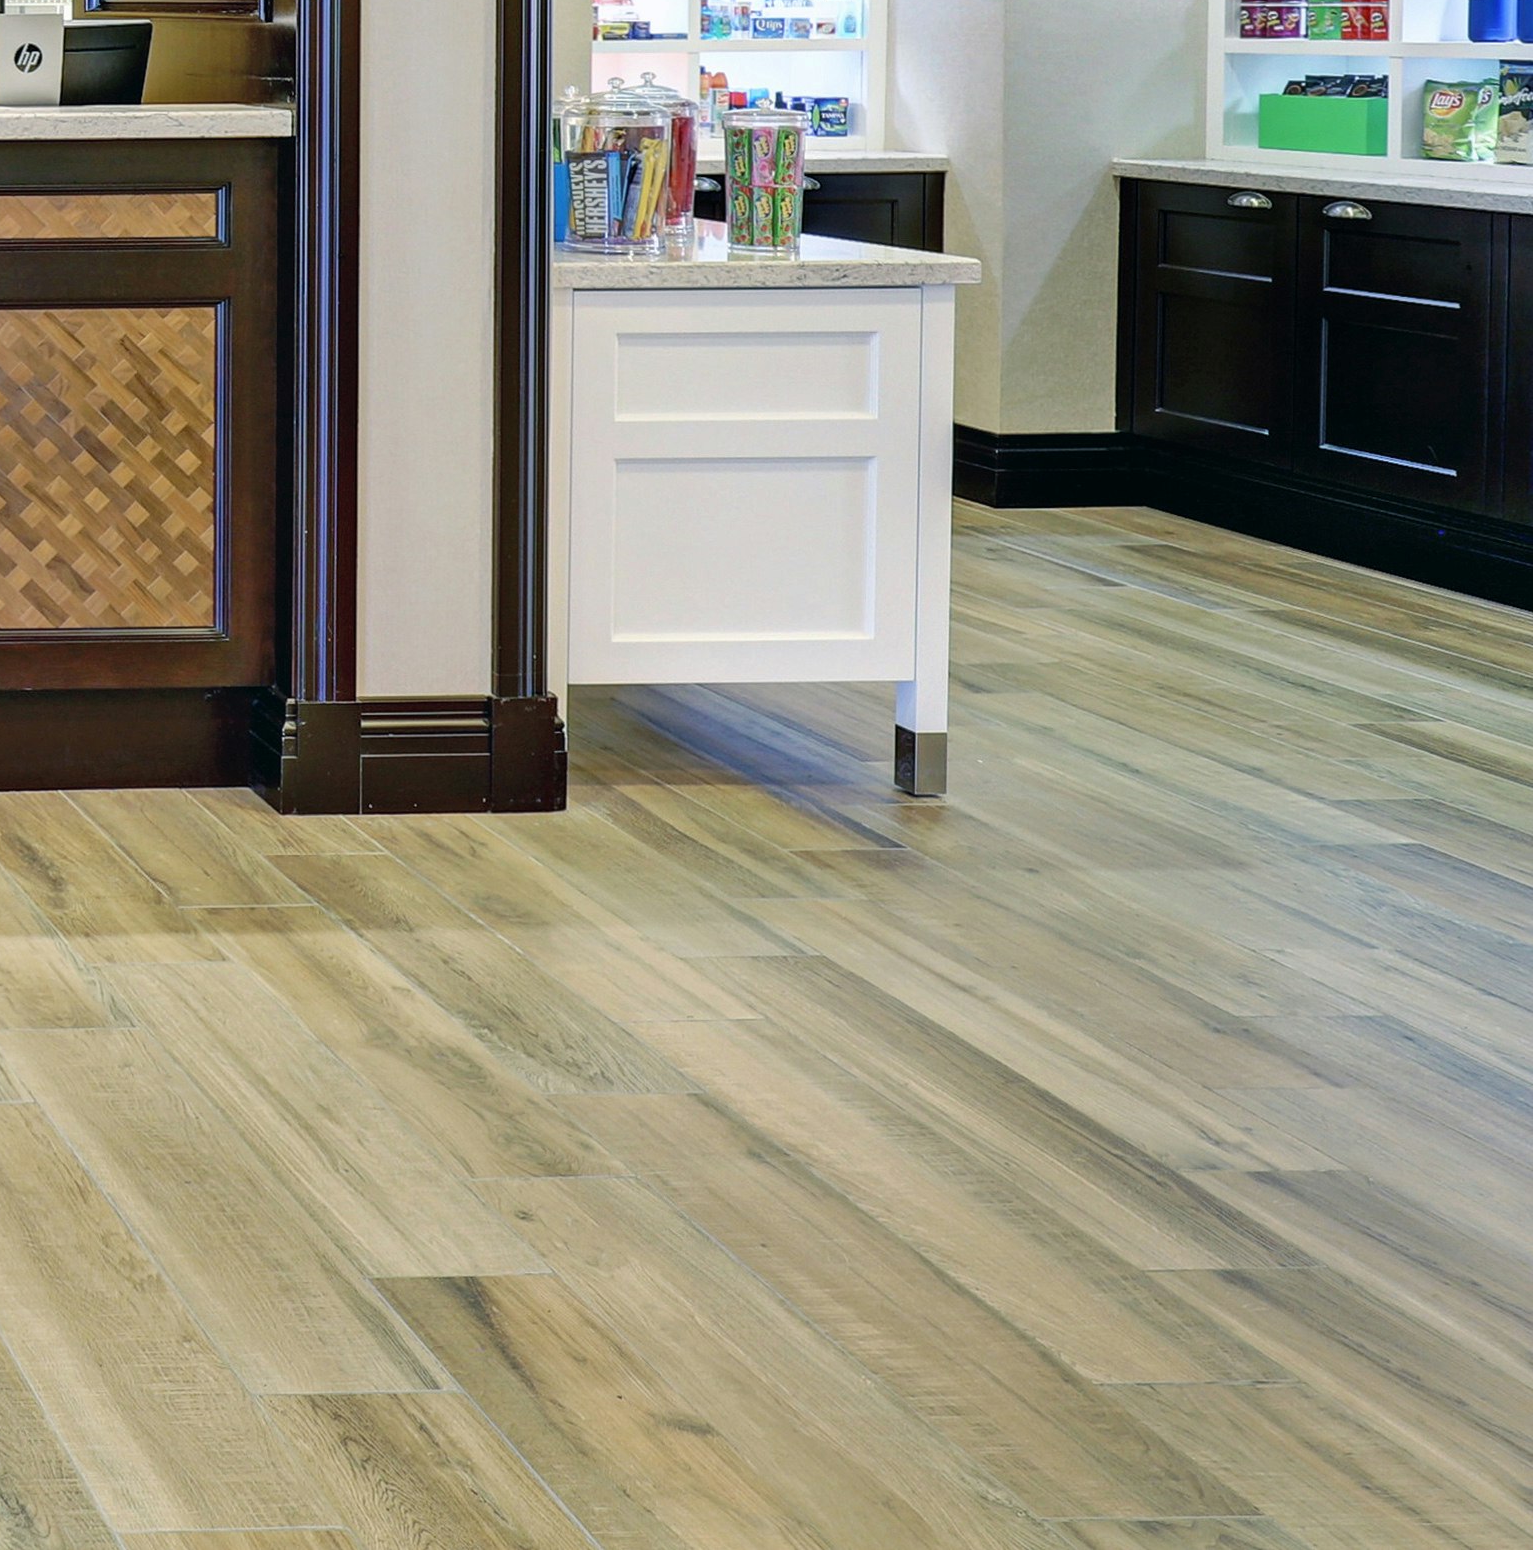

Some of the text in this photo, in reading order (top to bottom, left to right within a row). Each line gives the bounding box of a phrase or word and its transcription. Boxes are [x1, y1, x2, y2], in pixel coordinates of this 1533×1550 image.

[17, 43, 40, 73] hp
[1431, 92, 1463, 108] Lay's
[583, 157, 607, 234] HERSHEY'S
